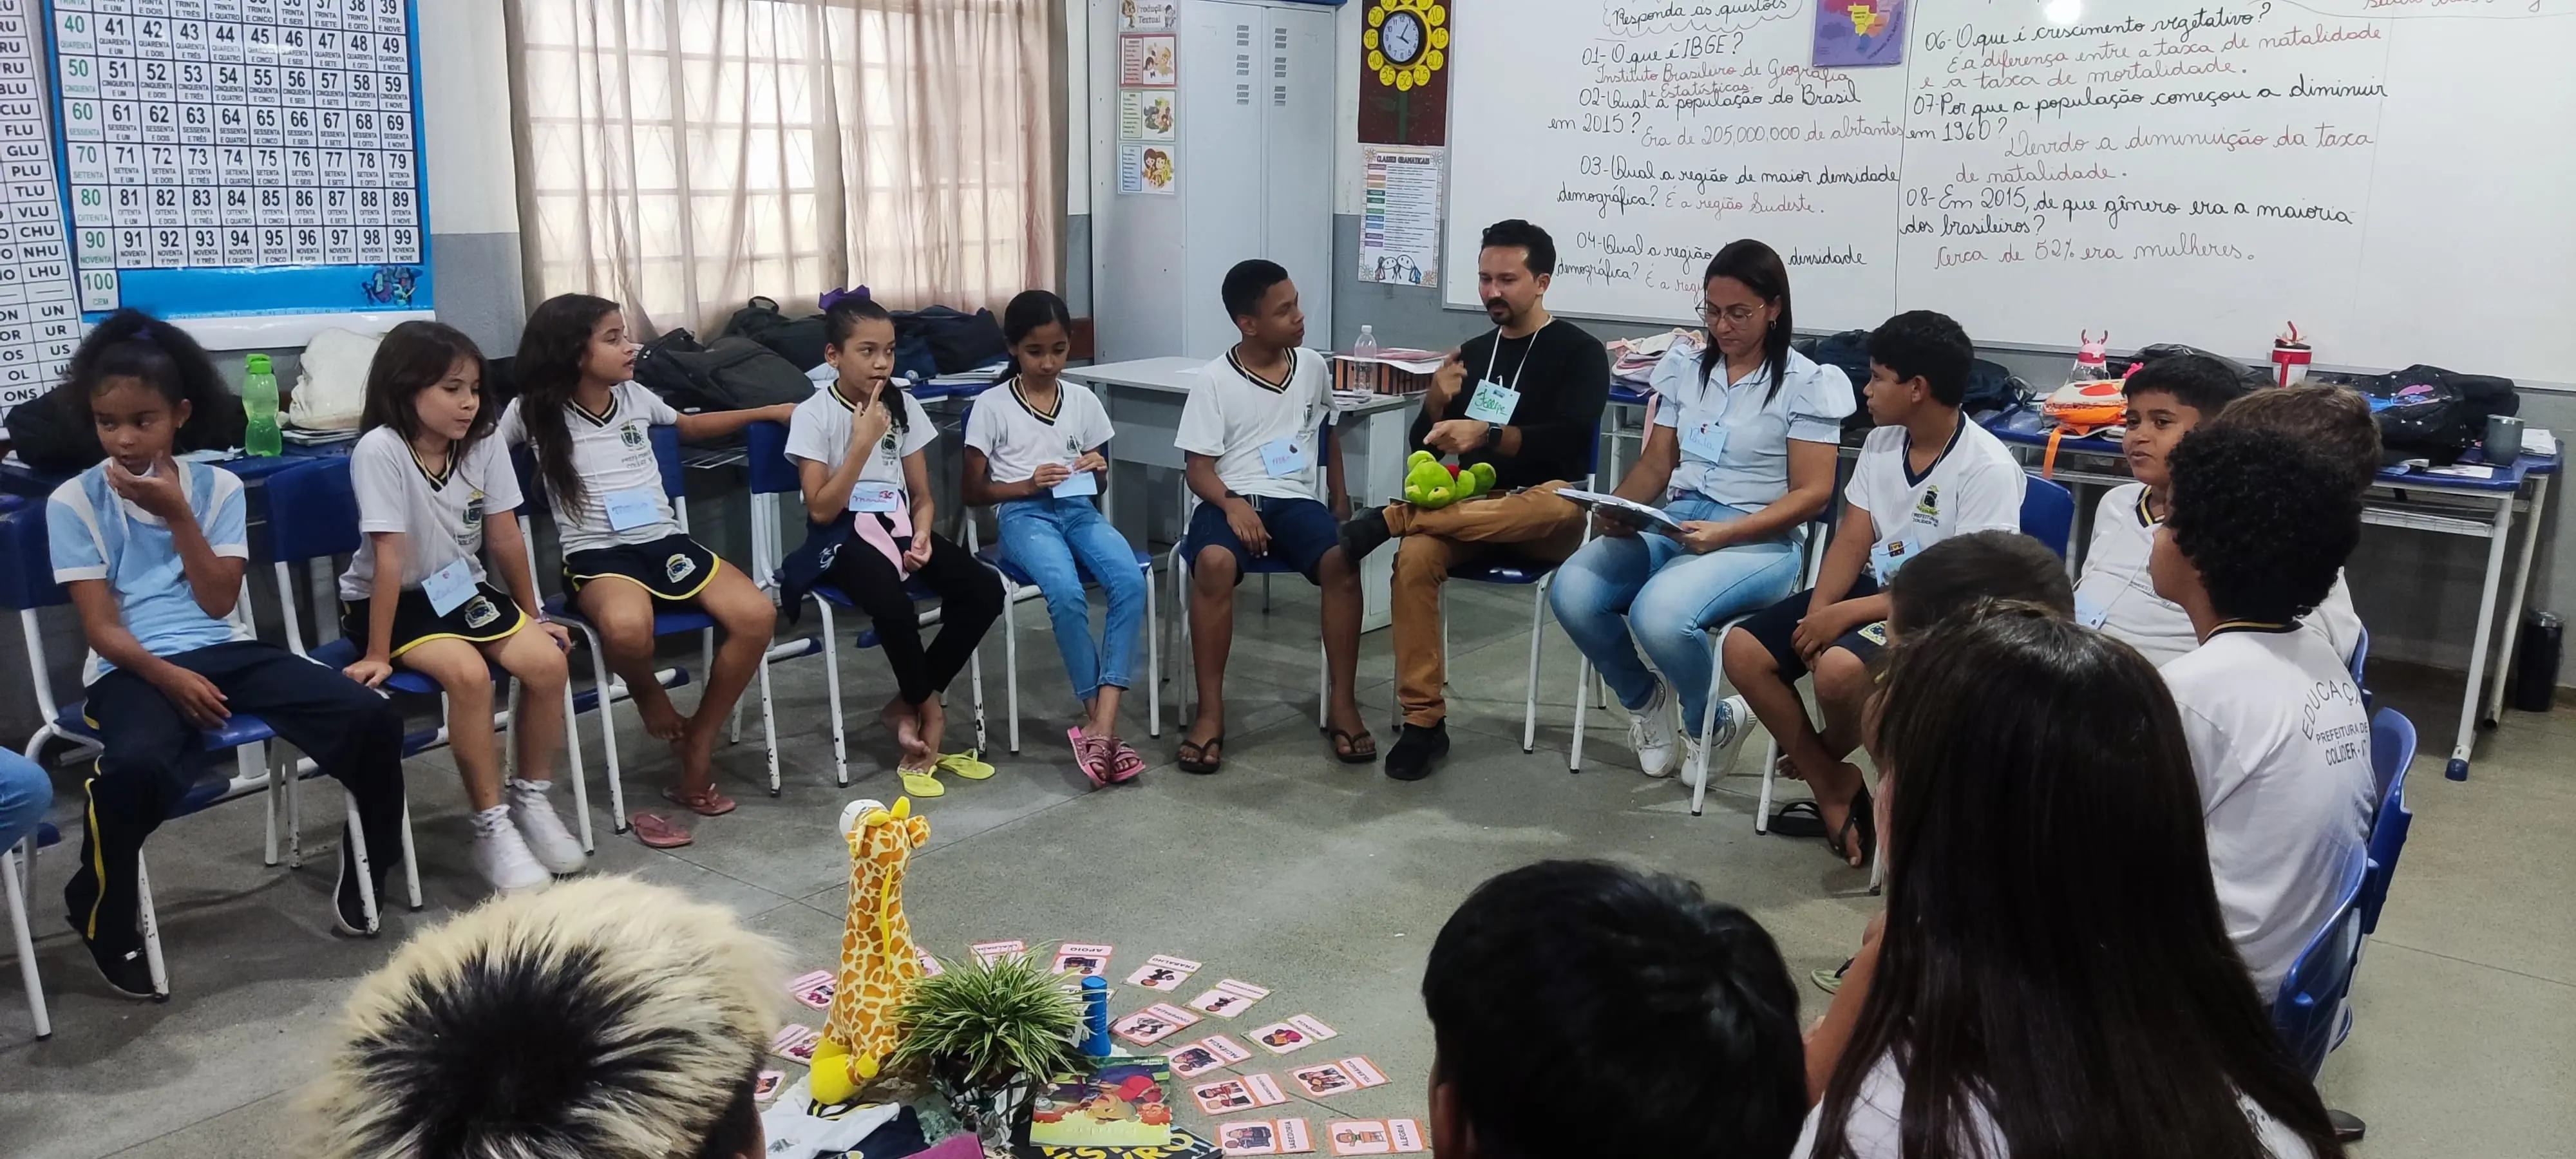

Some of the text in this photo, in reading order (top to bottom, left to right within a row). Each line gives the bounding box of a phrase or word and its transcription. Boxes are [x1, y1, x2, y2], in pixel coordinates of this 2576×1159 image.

[1430, 6, 1442, 22] 10
[1612, 3, 1685, 32] Responda
[1691, 6, 1712, 17] as
[64, 15, 84, 33] 40
[318, 33, 336, 49] 47
[1434, 30, 1446, 43] 15
[1972, 36, 2009, 57] que
[2031, 15, 2146, 42] crescimento
[383, 37, 399, 53] 49
[1980, 49, 2069, 79] diferença
[2075, 41, 2127, 62] entre
[2139, 49, 2152, 59] a
[2154, 37, 2215, 57] taxa
[2221, 32, 2249, 52] de
[2259, 23, 2382, 50] natalidade
[1370, 52, 1381, 67] 40
[1429, 53, 1441, 67] 20
[1626, 50, 1663, 73] que
[109, 61, 128, 79] 51
[254, 69, 272, 86] 55
[1381, 67, 1394, 82] 35
[1595, 59, 1848, 89] Instituto Brasileiro de Geografia
[354, 75, 370, 91] 58
[1942, 77, 1967, 89] a
[1973, 70, 2040, 90] taxa
[2047, 68, 2078, 86] de
[1676, 88, 1763, 121] população
[1768, 86, 1794, 104] do
[1802, 79, 1861, 105] Brasil
[1971, 103, 2009, 125] que
[2013, 100, 2029, 111] a
[2034, 86, 2145, 124] população
[2150, 90, 2252, 107] começou
[2257, 88, 2281, 98] a
[2289, 73, 2389, 97] diminuir
[1, 104, 31, 115] CLU
[149, 106, 169, 122] 62
[6, 124, 33, 136] FLU
[387, 115, 404, 131] 69
[1548, 118, 1577, 129] em
[1642, 126, 1672, 147] Era
[1677, 127, 1695, 146] de
[1804, 120, 1825, 142] de
[1906, 129, 1936, 140] em
[2095, 137, 2118, 151] a
[2125, 124, 2269, 152] diminuição
[2273, 124, 2308, 148] da
[2314, 122, 2374, 148] taxa
[6, 145, 39, 156] GLU
[223, 149, 243, 165] 74
[325, 152, 343, 167] 77
[12, 165, 41, 177] PLU
[1956, 162, 1980, 183] de
[1660, 171, 1674, 180] a
[1678, 167, 1728, 195] região
[1735, 165, 1756, 185] de
[1761, 169, 1812, 183] maior
[1817, 164, 1900, 185] densidade
[120, 189, 138, 206] 81
[392, 192, 409, 207] 89
[18, 205, 49, 218] VLU
[1681, 200, 1692, 209] a
[1696, 196, 1743, 221] região
[2034, 191, 2058, 211] de
[2062, 199, 2098, 222] que
[2103, 194, 2181, 229] gênero
[2189, 200, 2229, 215] era
[2234, 202, 2249, 214] a
[2257, 198, 2353, 224] maioria
[20, 225, 55, 238] CHU
[1900, 214, 1933, 235] dos
[196, 230, 214, 247] 93
[299, 230, 316, 245] 96
[363, 229, 380, 245] 98
[24, 245, 59, 258] NHU
[1788, 244, 1867, 267] densidade
[1935, 247, 1988, 269] Cerca
[1999, 243, 2025, 262] de
[2035, 238, 2074, 261] 52%
[2079, 246, 2124, 260] era
[1647, 247, 1661, 256] a
[1661, 245, 1712, 275] região
[29, 265, 61, 278] LHU
[84, 273, 113, 290] 100
[1661, 279, 1670, 290] a
[1674, 277, 1706, 303] regi
[41, 305, 64, 317] UN
[8, 370, 30, 381] OL
[2316, 722, 2368, 745] PREFEITURA DE
[1152, 957, 1196, 970] TRABALHO
[1285, 1121, 1297, 1149] SABEDORIA
[1397, 1123, 1409, 1147] ALEGRIA
